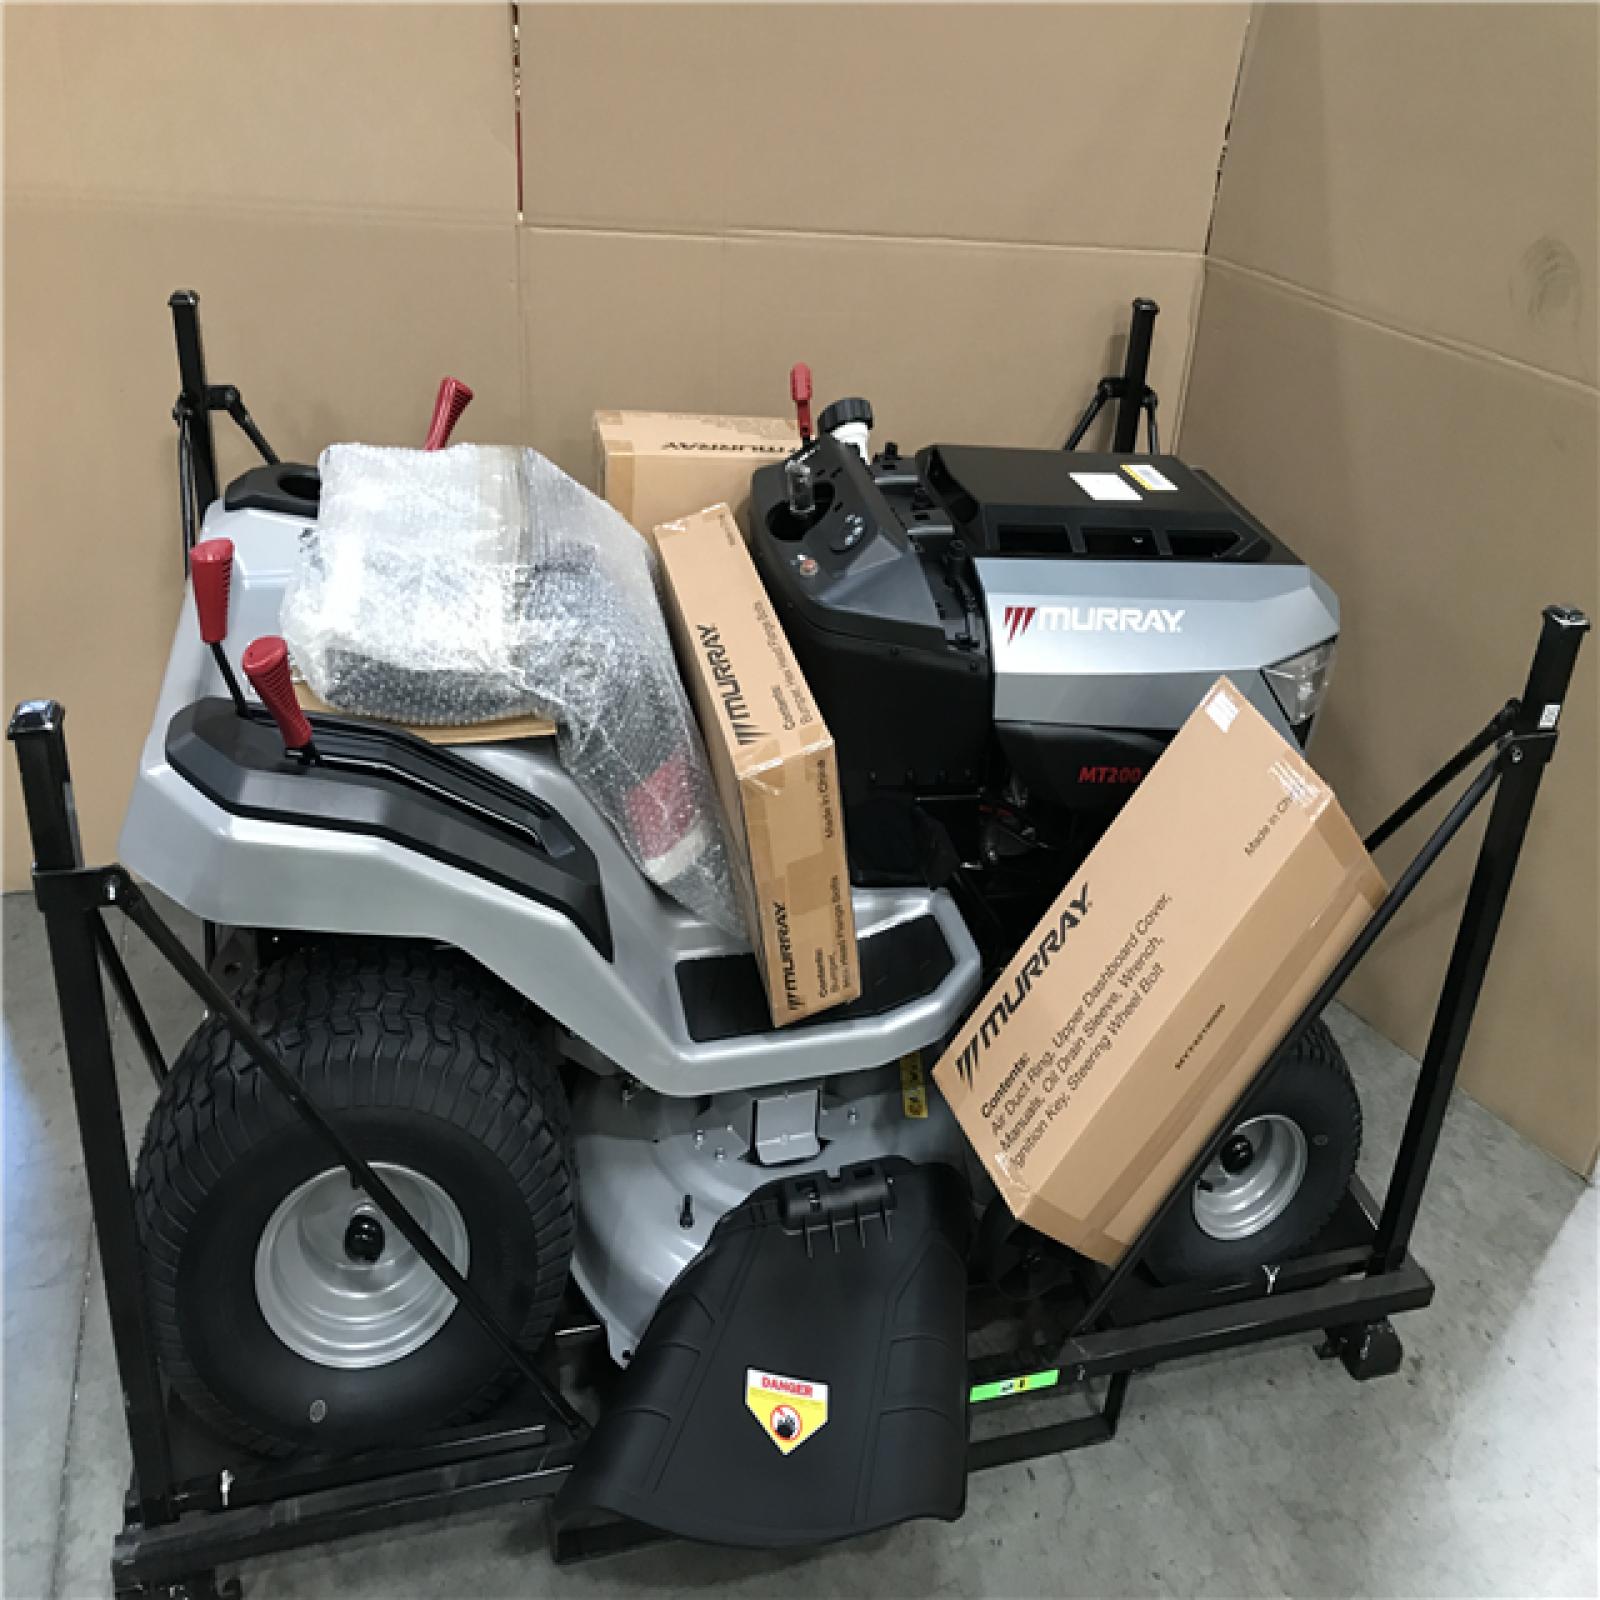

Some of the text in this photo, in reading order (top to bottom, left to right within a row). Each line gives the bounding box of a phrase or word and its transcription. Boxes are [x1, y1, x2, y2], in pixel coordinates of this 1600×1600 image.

[1039, 606, 1185, 633] MURRAY
[697, 624, 750, 721] MURRAY
[774, 901, 798, 993] MURRAY
[978, 881, 1091, 1050] MURRAY
[992, 893, 1172, 1142] Air Duct Ring, Upper Dashboard Cover,
[1000, 937, 1165, 1152] Manuals, Oil Drain Sleeve, Wrench,
[1010, 962, 1164, 1169] Ignition Key, Steering Wheel Bolt
[980, 1053, 1030, 1118] Contents:
[762, 1375, 813, 1397] DANGER
